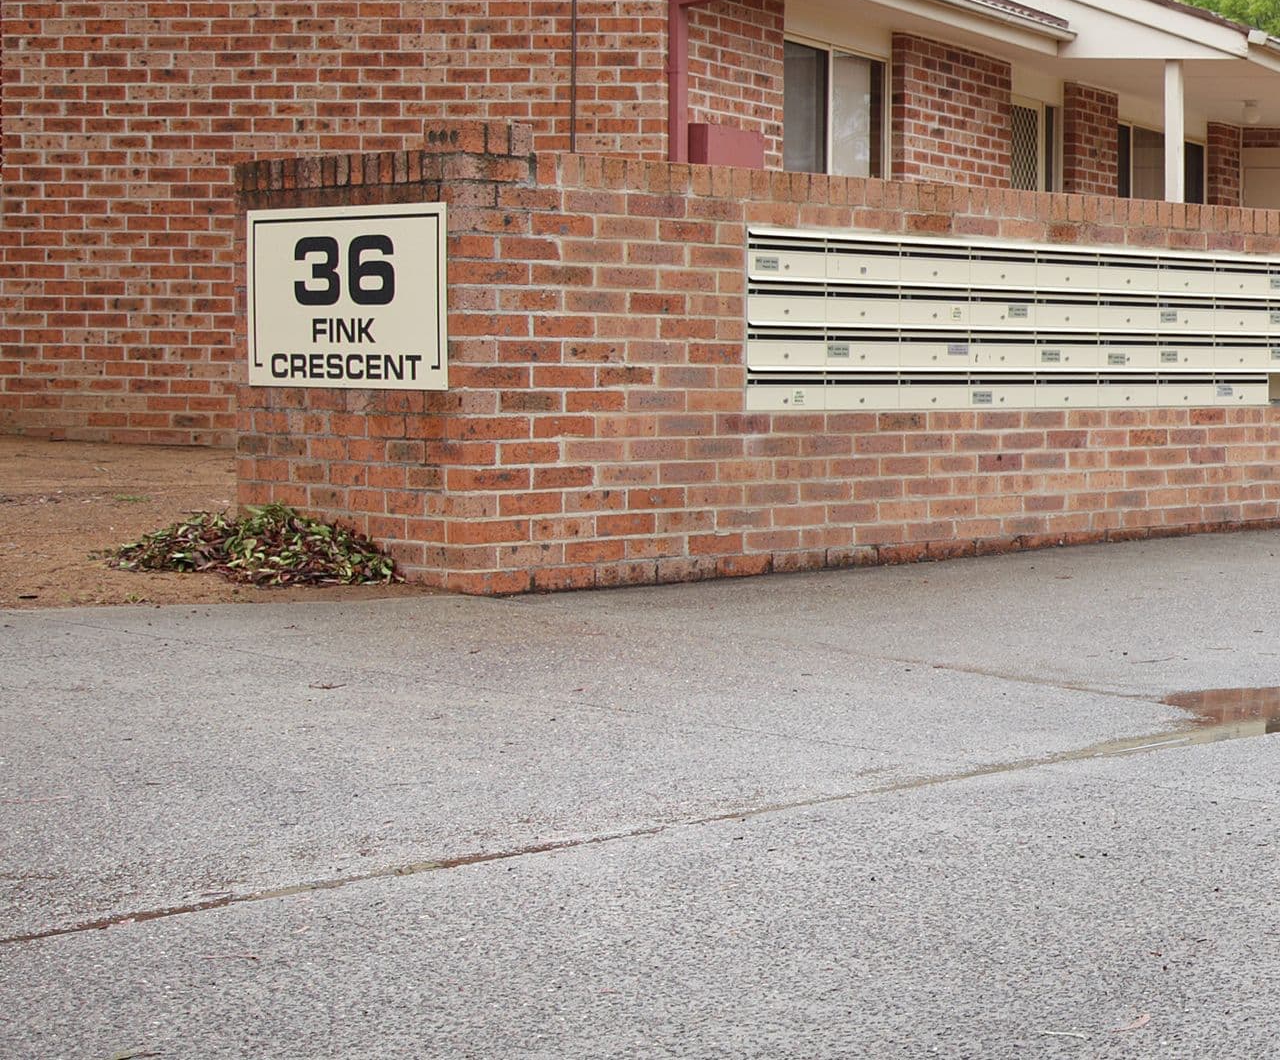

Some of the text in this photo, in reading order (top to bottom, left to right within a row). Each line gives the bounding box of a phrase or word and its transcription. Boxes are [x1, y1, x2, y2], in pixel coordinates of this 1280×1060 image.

[294, 234, 396, 306] 36
[312, 318, 376, 343] FINK
[271, 353, 422, 380] CRESCENT
